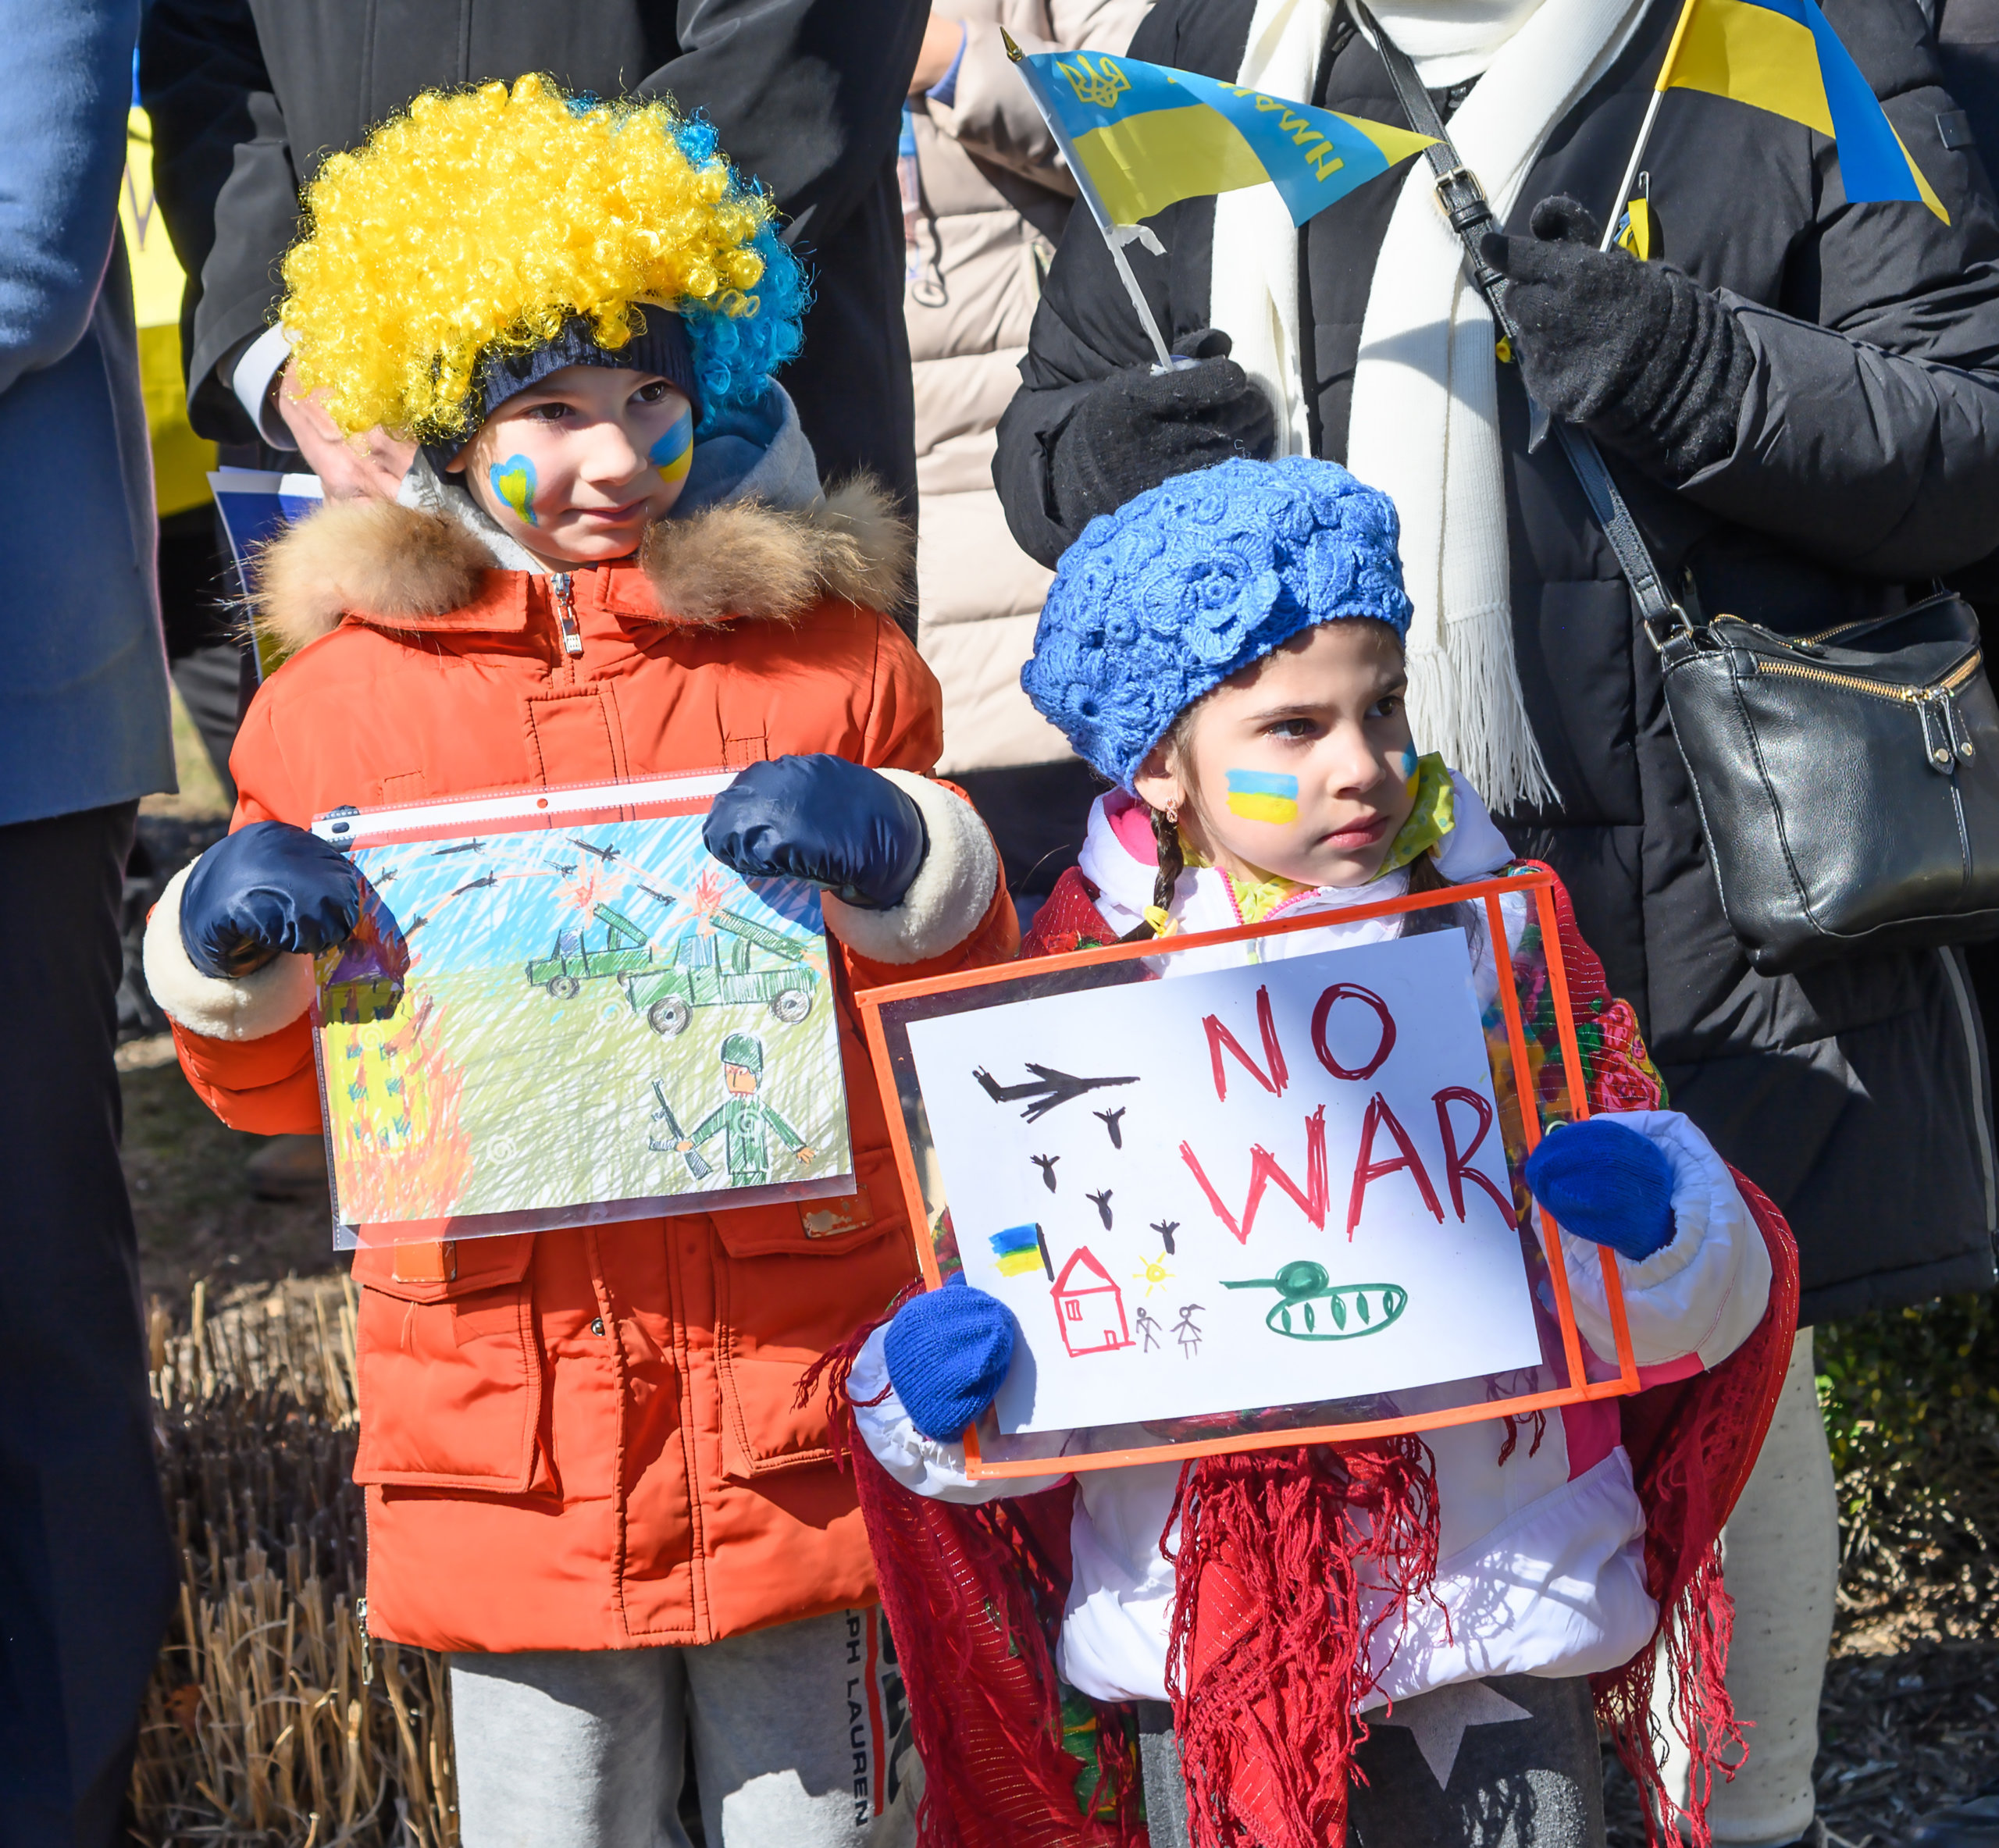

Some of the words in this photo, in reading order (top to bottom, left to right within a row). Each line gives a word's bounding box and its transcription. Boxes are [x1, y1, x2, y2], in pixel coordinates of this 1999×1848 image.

[1202, 982, 1397, 1102] NO
[1178, 1085, 1518, 1245] WAR
[846, 1609, 861, 1665] PH
[846, 1678, 869, 1828] LAUREN
